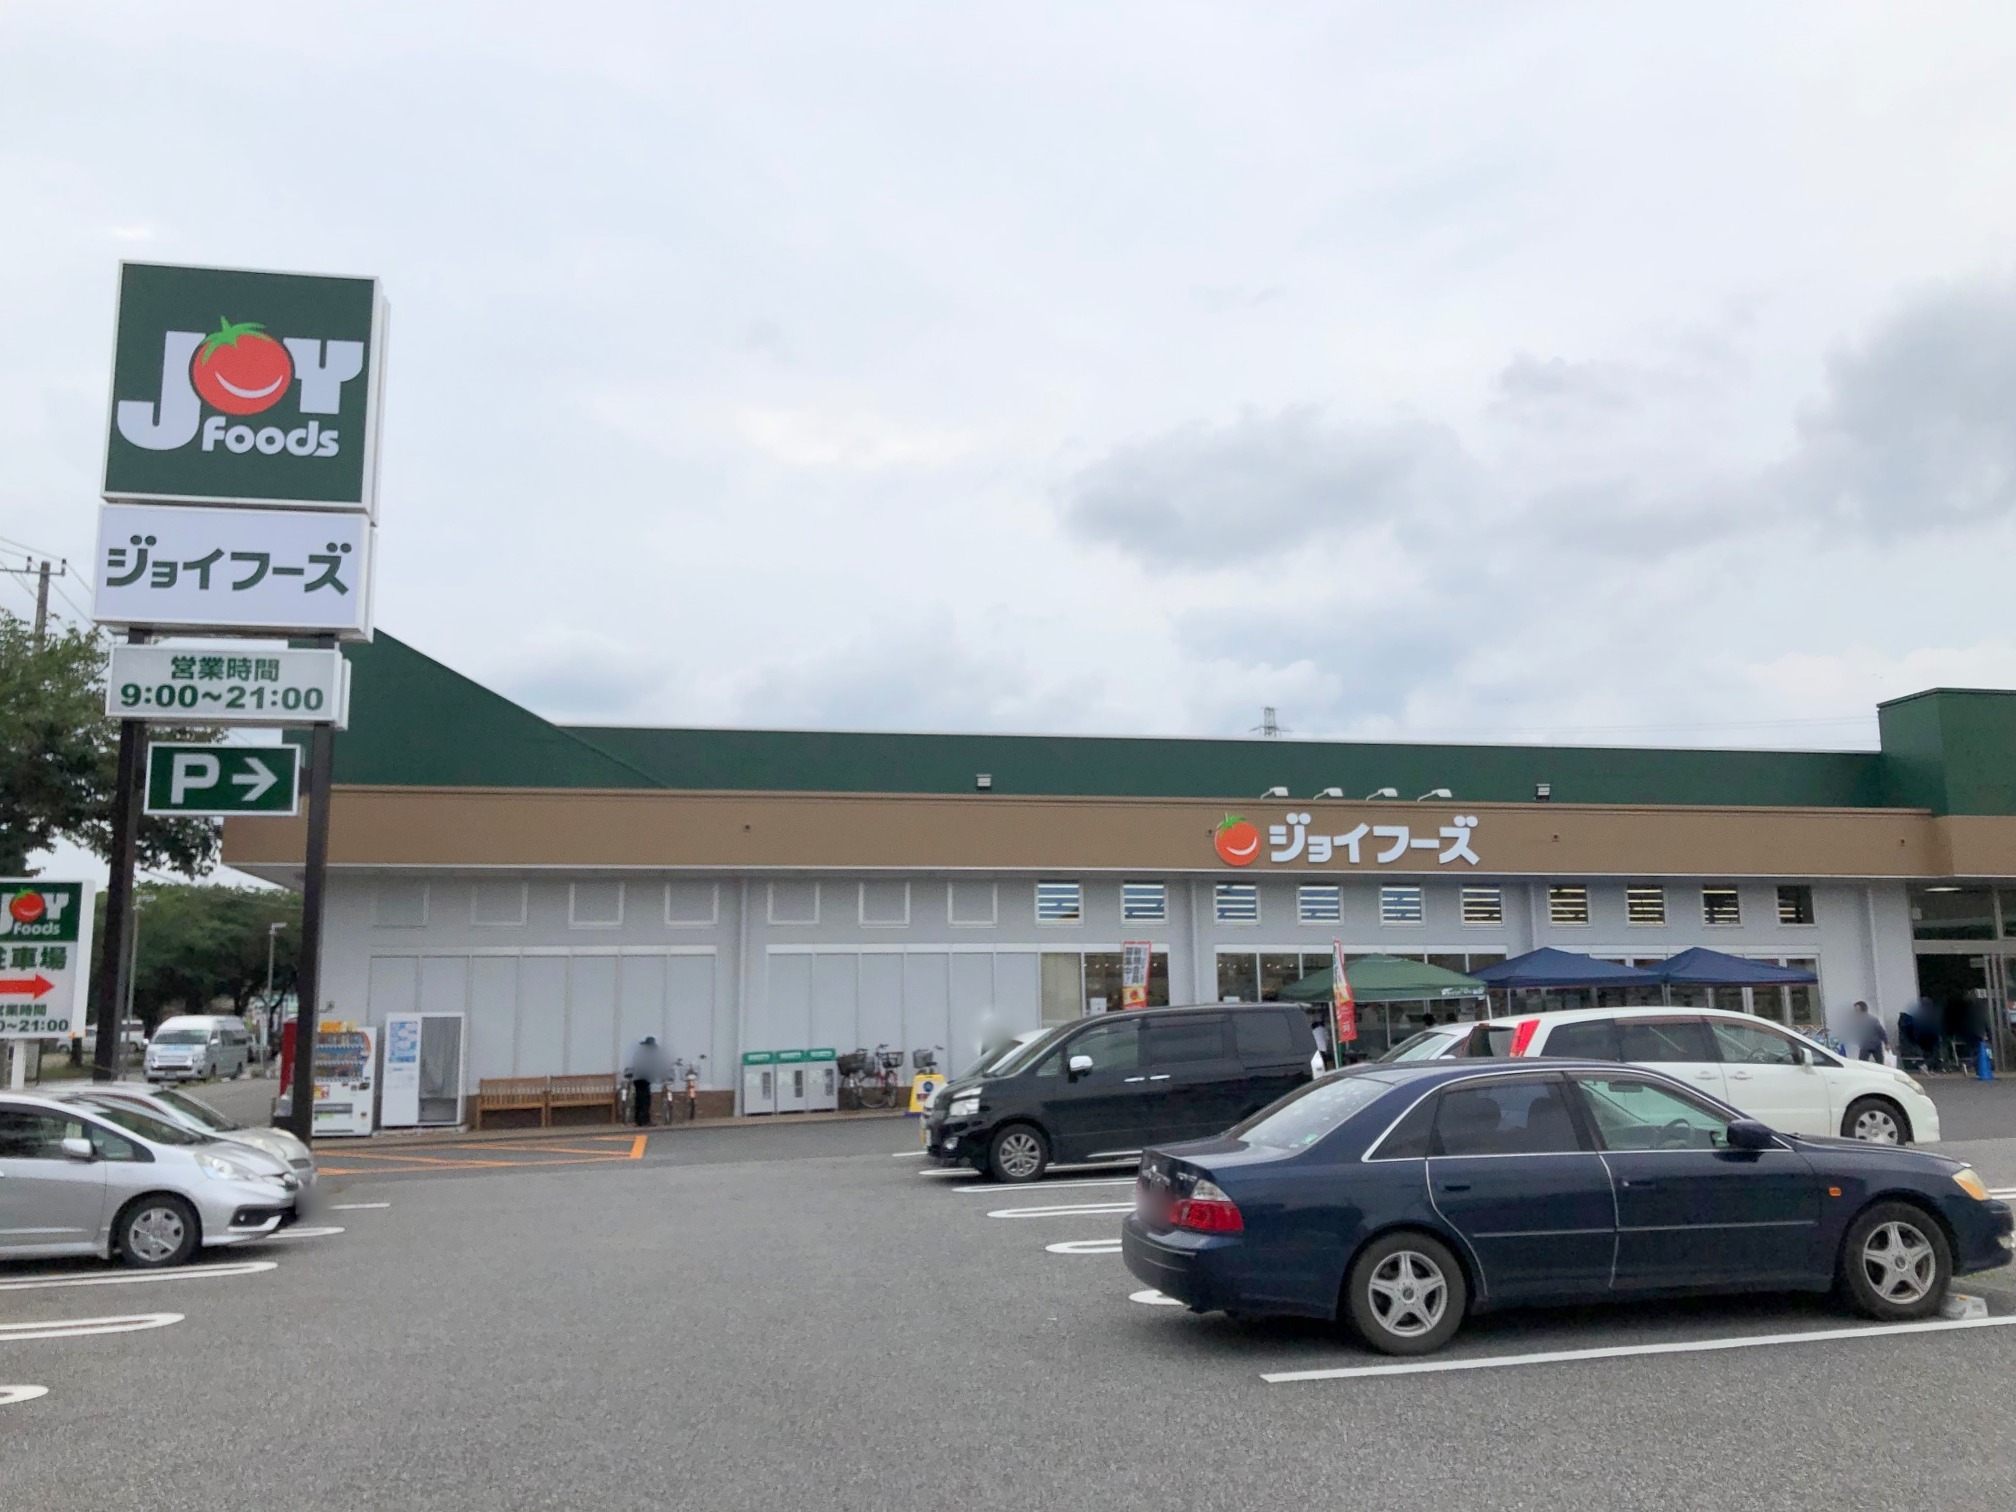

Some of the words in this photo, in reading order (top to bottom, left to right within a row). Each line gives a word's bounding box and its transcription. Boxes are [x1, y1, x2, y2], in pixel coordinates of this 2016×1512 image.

[202, 417, 340, 458] foods
[106, 535, 352, 597] ジョイフーズ
[171, 655, 281, 682] 営業時間
[170, 753, 220, 804] P
[1269, 812, 1481, 865] ジョイフーズ
[13, 921, 60, 936] foods
